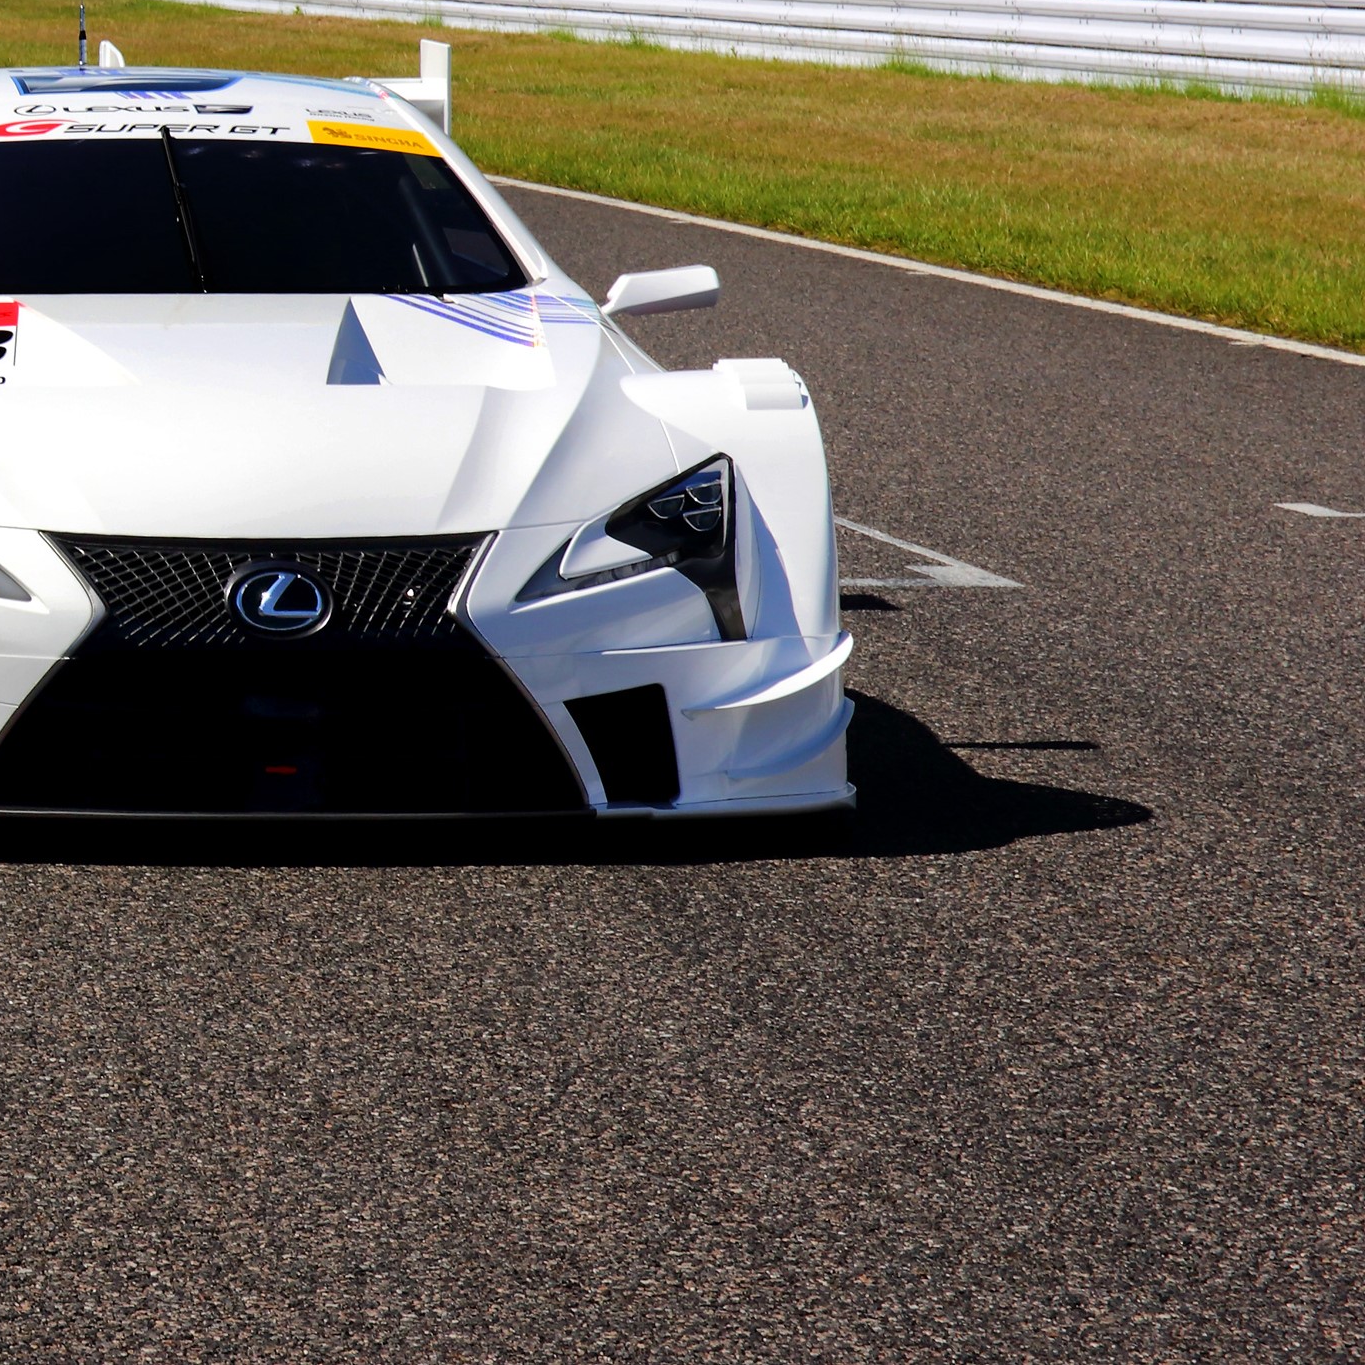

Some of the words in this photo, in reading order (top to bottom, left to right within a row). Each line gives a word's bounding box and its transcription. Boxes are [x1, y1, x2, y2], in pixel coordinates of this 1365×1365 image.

[64, 105, 188, 114] LEXUS
[64, 123, 217, 134] SUPER
[228, 126, 290, 135] GT
[354, 134, 424, 149] SINGHA
